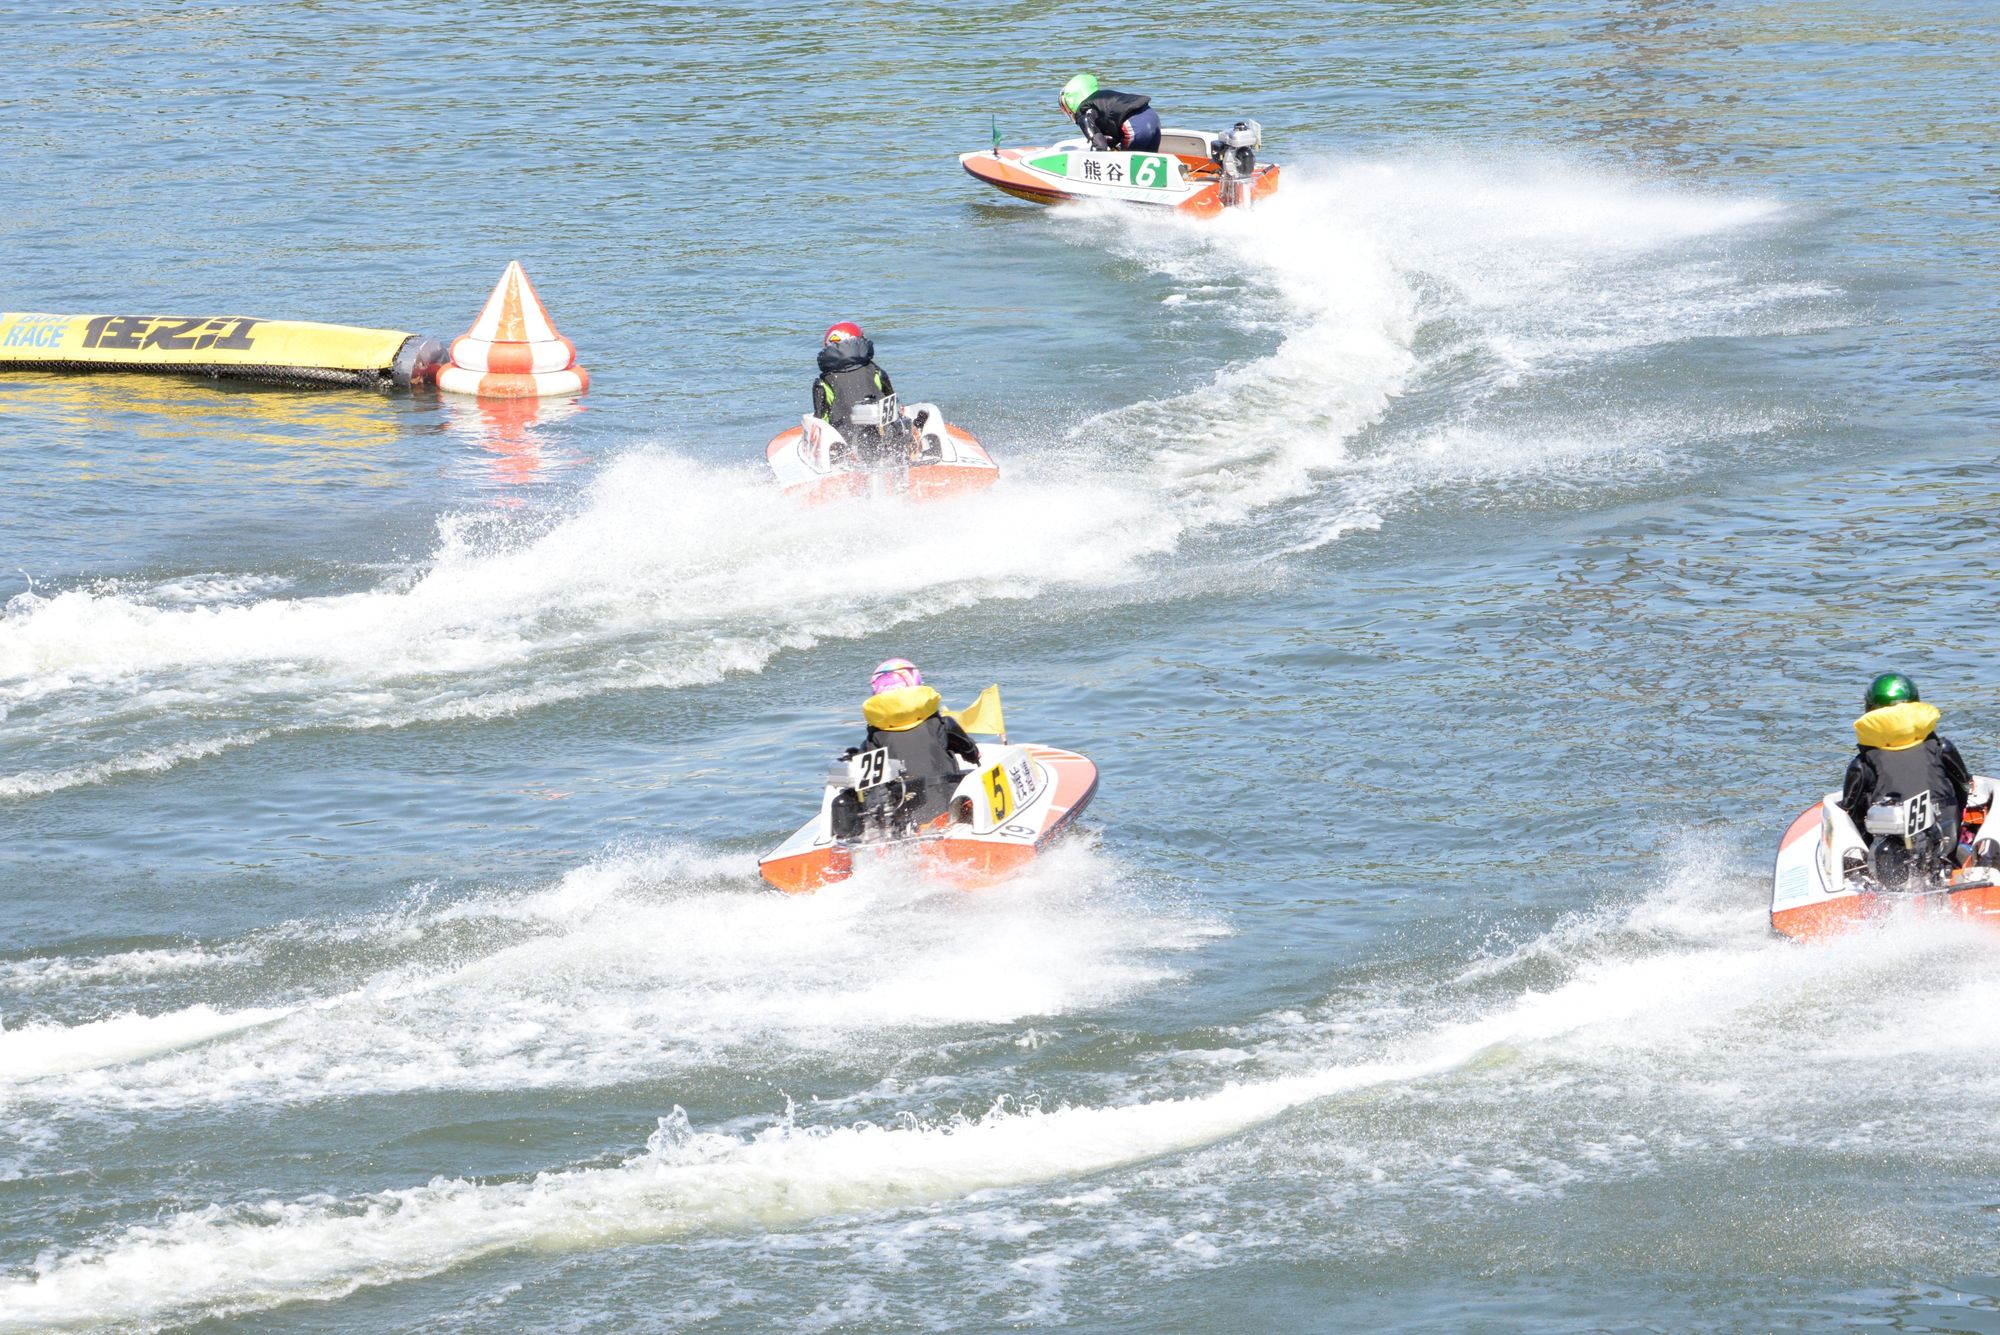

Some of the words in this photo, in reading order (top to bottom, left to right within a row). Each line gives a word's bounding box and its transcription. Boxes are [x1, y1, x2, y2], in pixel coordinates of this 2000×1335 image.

[1083, 159, 1124, 181] 熊谷
[1135, 156, 1160, 187] 6
[3, 324, 68, 348] RACE
[858, 749, 885, 789] 29
[991, 766, 1005, 820] 5
[1907, 793, 1928, 835] 65
[999, 825, 1036, 839] 19
